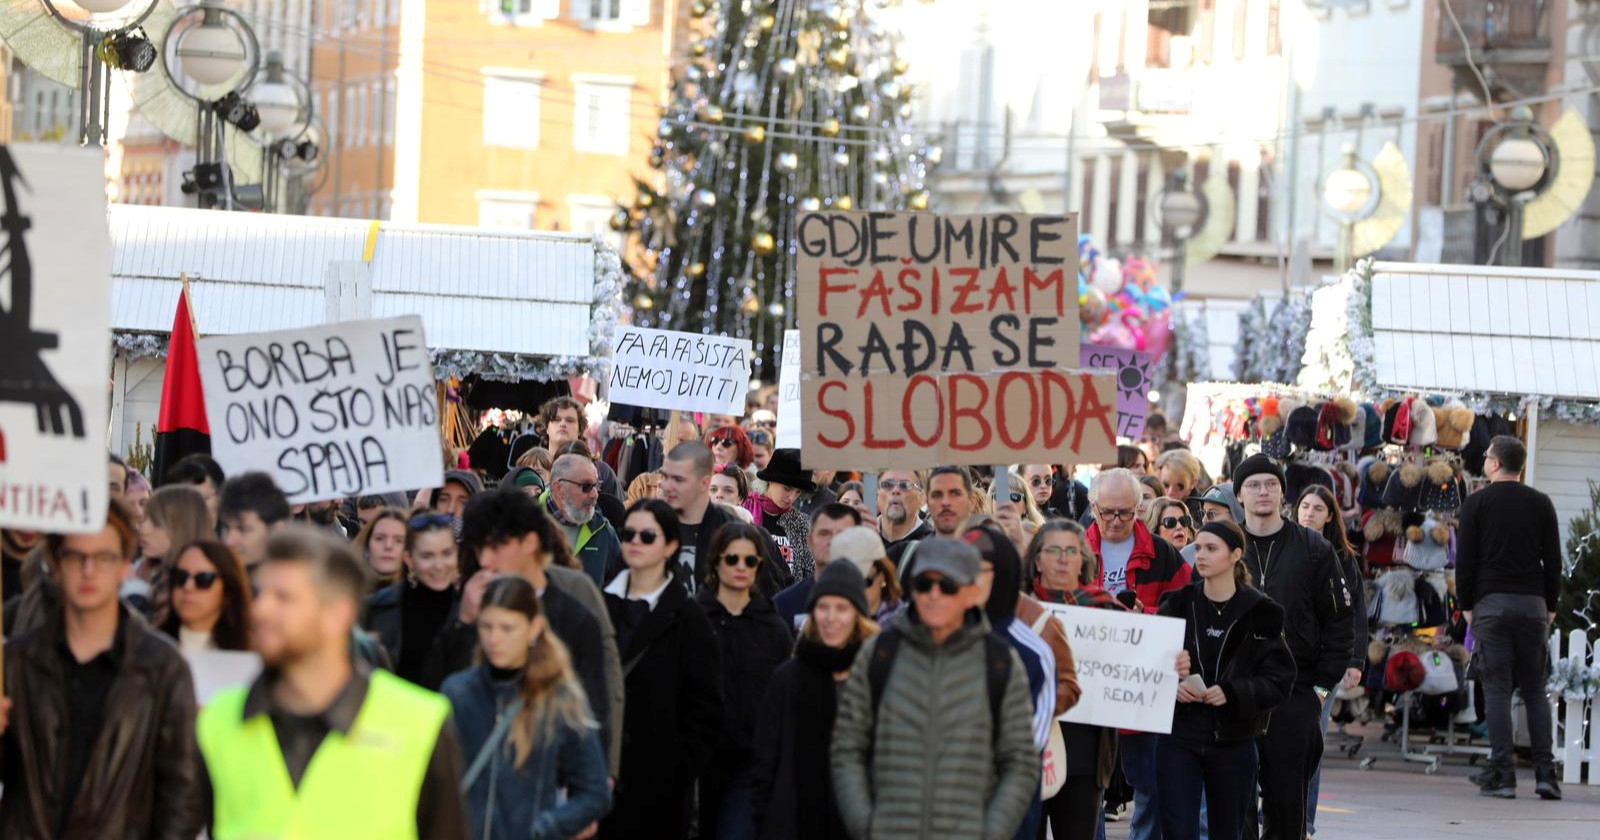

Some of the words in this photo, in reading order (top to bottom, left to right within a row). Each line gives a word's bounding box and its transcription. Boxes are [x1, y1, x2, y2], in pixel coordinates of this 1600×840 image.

[799, 211, 899, 267] GDJE
[908, 213, 1070, 270] UMIRE
[816, 257, 1065, 319] FAŠIZAM
[216, 336, 356, 392] BORBA
[376, 329, 421, 385] JE
[615, 332, 646, 356] FA
[648, 334, 668, 358] FA
[670, 337, 746, 371] FAŠISTA
[816, 317, 975, 377] RAĐA
[989, 313, 1059, 368] SE
[225, 395, 299, 444] ONO
[309, 385, 374, 433] ŠTO
[383, 383, 437, 431] NAS
[610, 363, 673, 395] NEMOJ
[677, 371, 714, 400] BITI
[717, 378, 739, 403] TI
[816, 369, 1117, 455] SLOBODA
[277, 435, 391, 496] SPAJA
[1074, 624, 1143, 646] NASILJU
